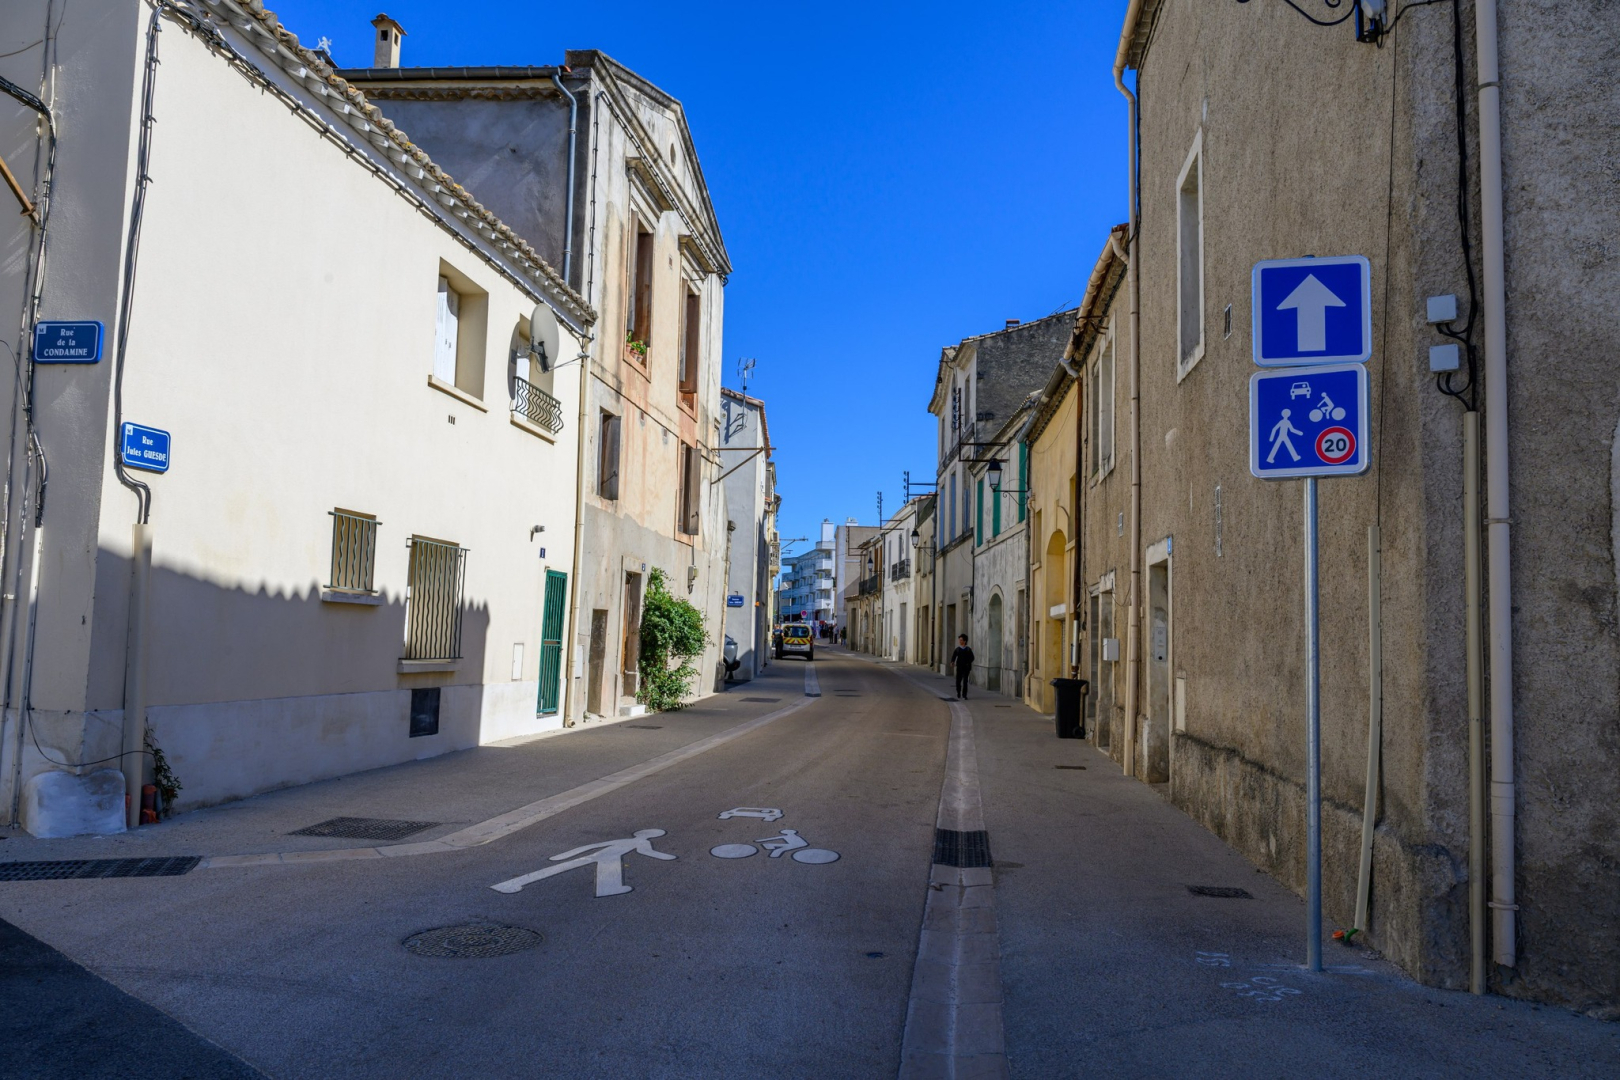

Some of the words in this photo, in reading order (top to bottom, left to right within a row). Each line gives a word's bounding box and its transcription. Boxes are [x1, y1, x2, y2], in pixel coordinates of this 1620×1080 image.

[60, 328, 75, 336] Rue
[56, 338, 66, 346] de
[68, 338, 76, 346] la
[43, 348, 88, 357] CONDAMINE
[142, 435, 154, 446] Rue
[1324, 438, 1347, 453] 20
[127, 445, 142, 457] Jules
[143, 450, 167, 462] GUESDE
